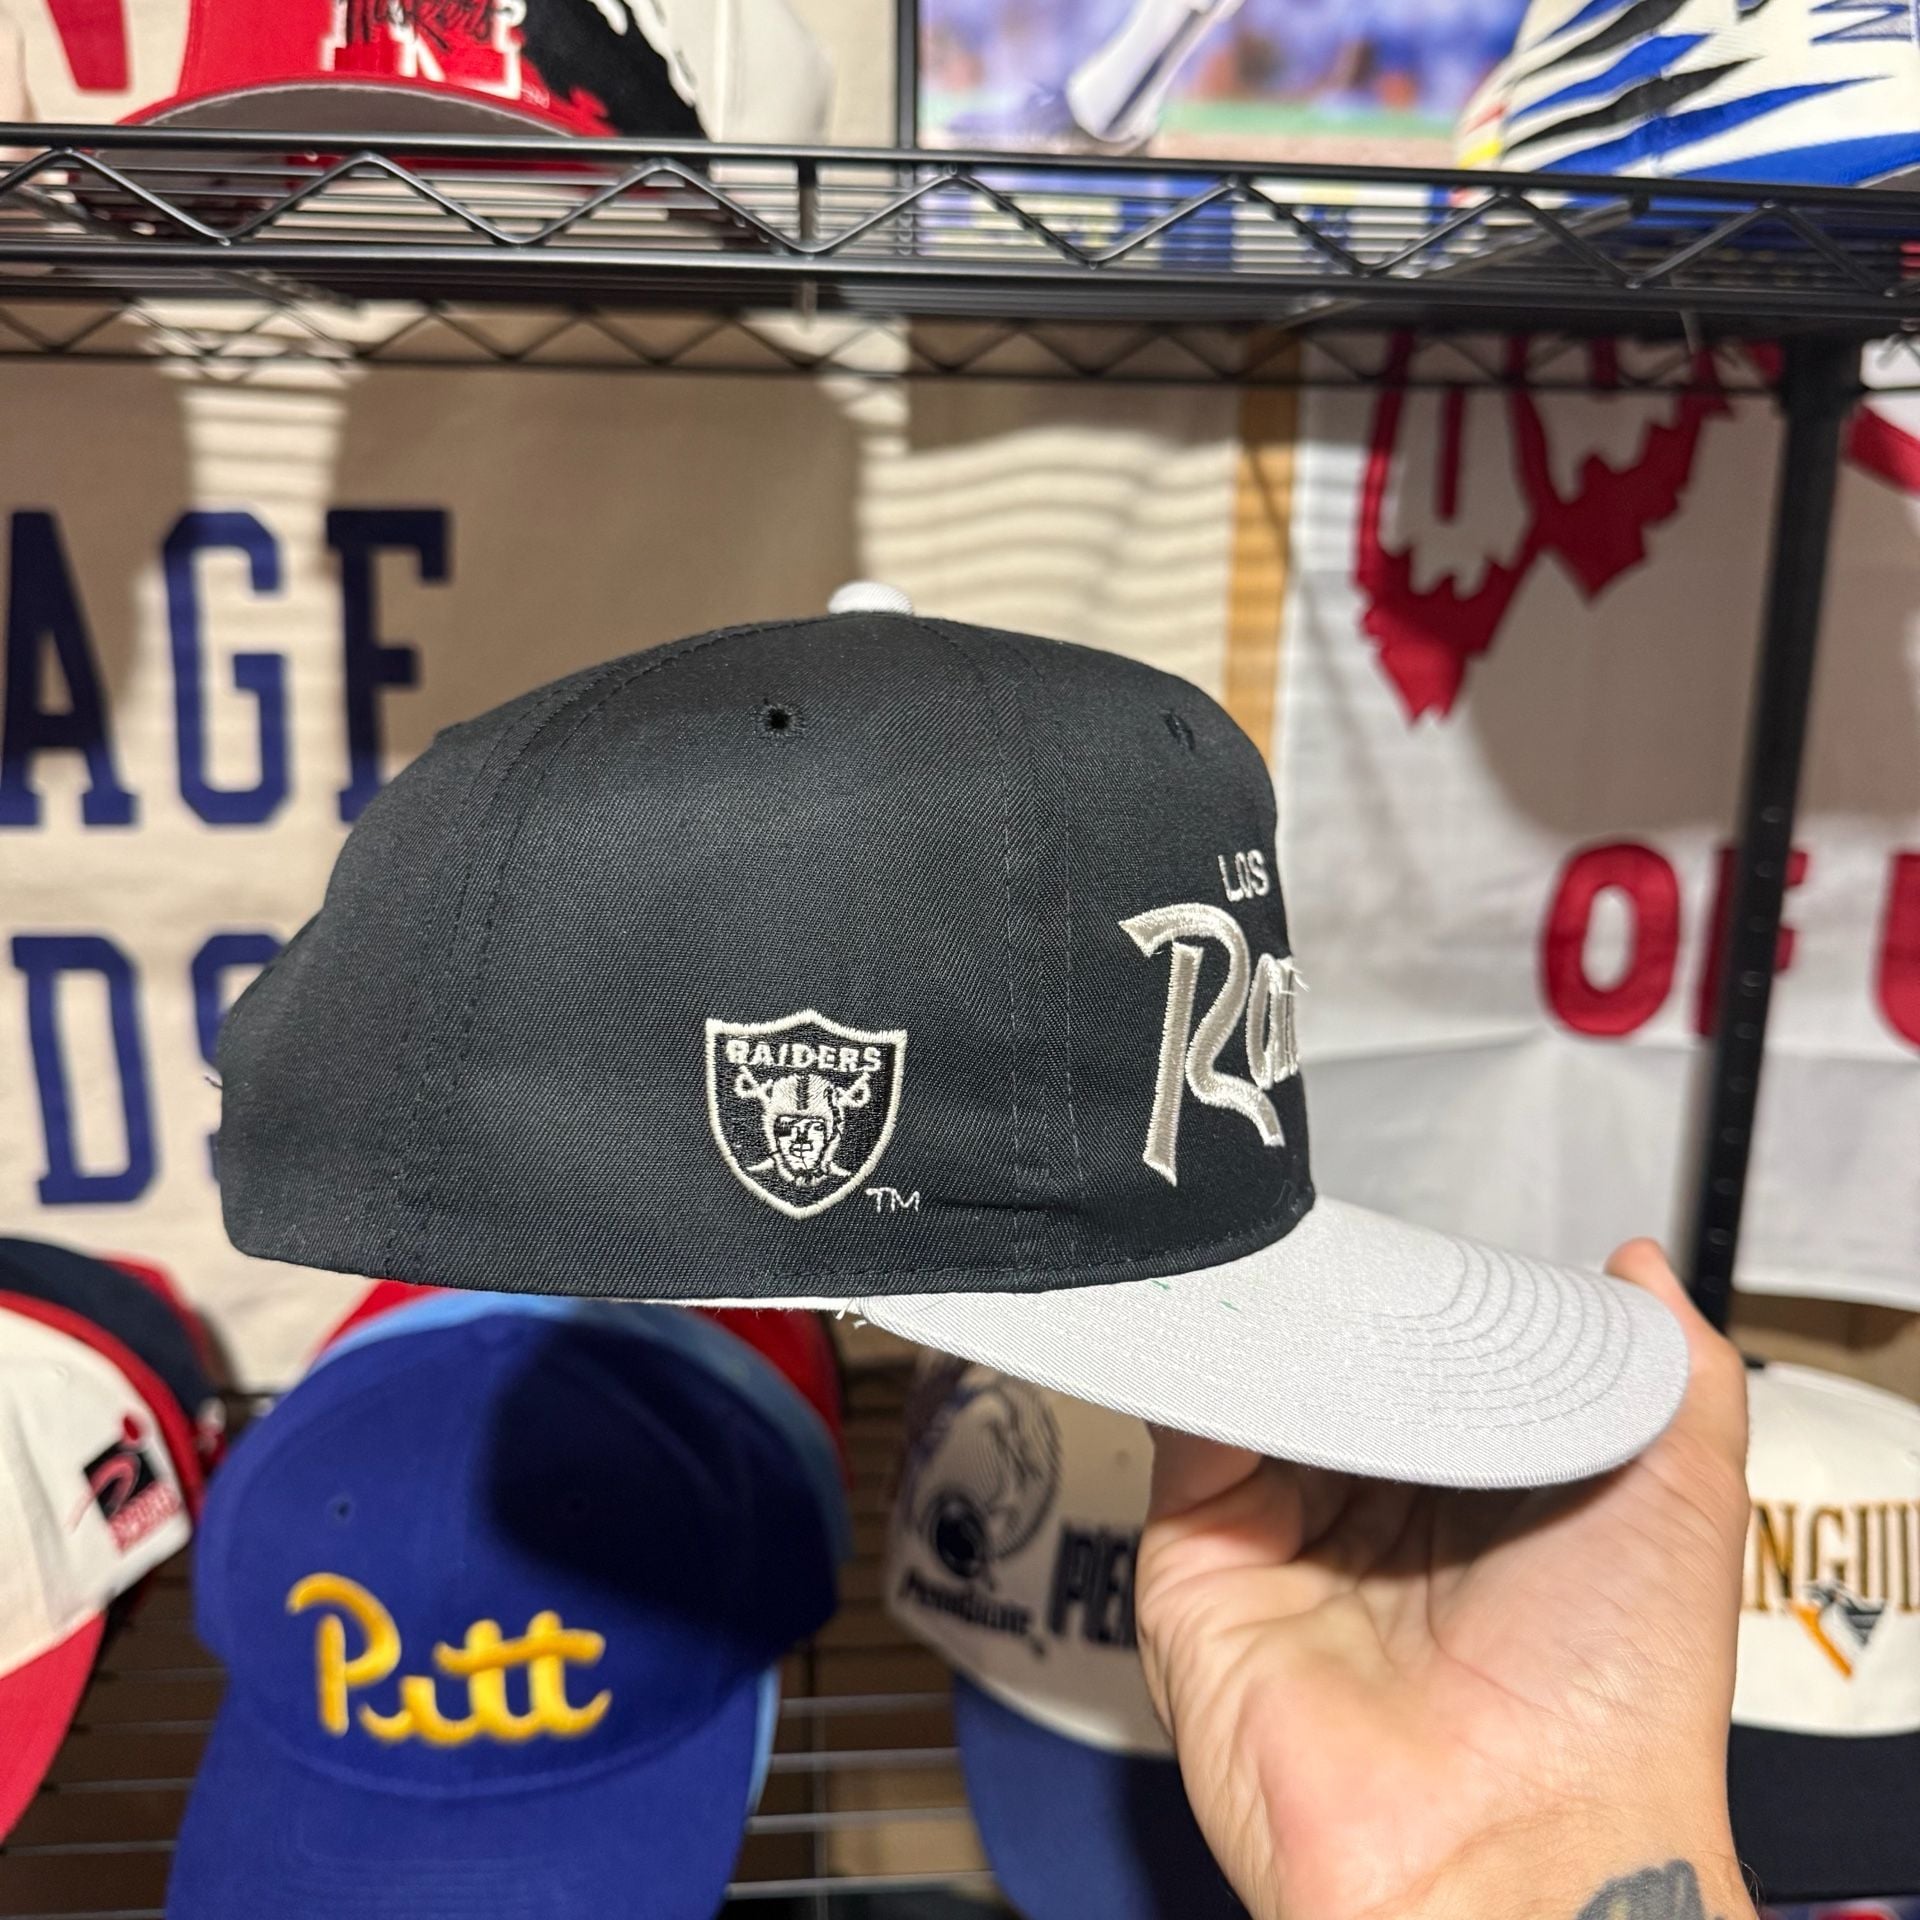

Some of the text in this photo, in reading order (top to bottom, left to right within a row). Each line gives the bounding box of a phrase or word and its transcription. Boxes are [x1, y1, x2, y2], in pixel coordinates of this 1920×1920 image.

[1218, 849, 1270, 902] LOS
[725, 1039, 882, 1073] RAIDERS
[1118, 902, 1301, 1188] Ra
[865, 1186, 921, 1213] TM
[285, 1571, 612, 1747] Pitt
